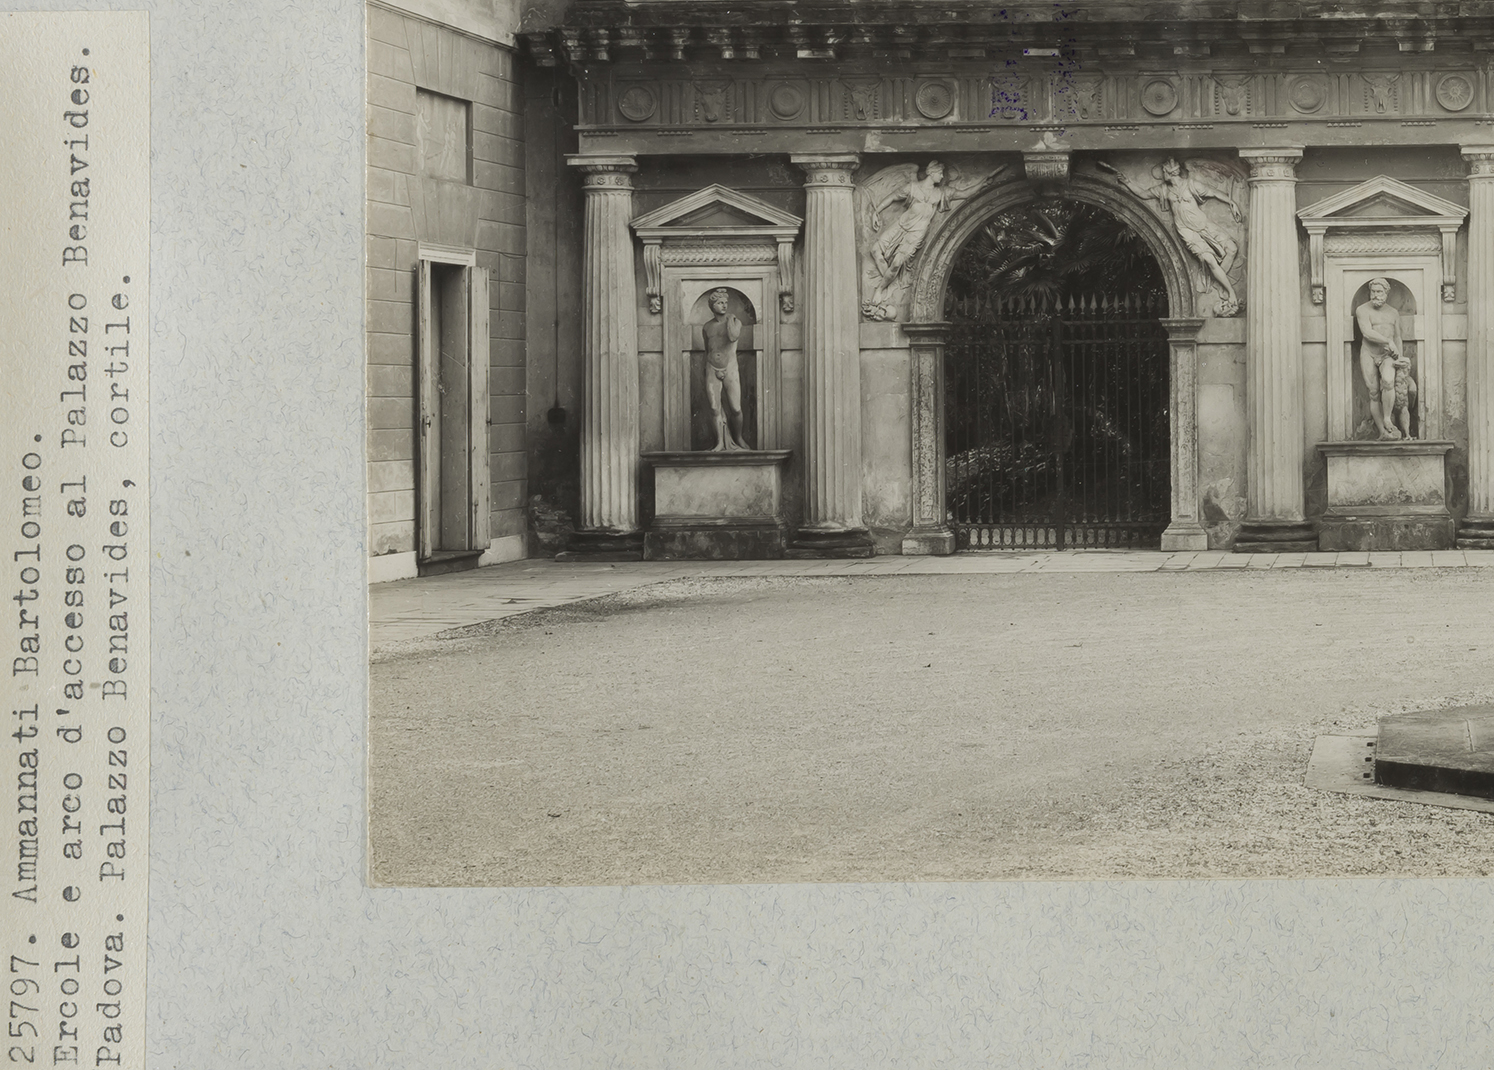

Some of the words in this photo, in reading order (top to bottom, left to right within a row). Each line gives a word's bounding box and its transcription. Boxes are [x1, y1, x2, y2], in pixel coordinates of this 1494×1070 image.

[62, 47, 91, 267] Benavides.
[60, 293, 89, 449] Palazzo
[104, 275, 131, 448] cortile.
[13, 433, 42, 678] Bartolomeo.
[60, 474, 87, 519] al
[56, 543, 85, 745] d'accesso
[101, 479, 136, 701] Benavides,
[11, 703, 40, 904] Ammannati
[61, 772, 83, 860] arco
[99, 726, 128, 883] Palazzo
[61, 885, 82, 903] e
[7, 933, 39, 1064] 25797.
[53, 932, 80, 1067] Ercole
[96, 913, 125, 1068] Padova.
